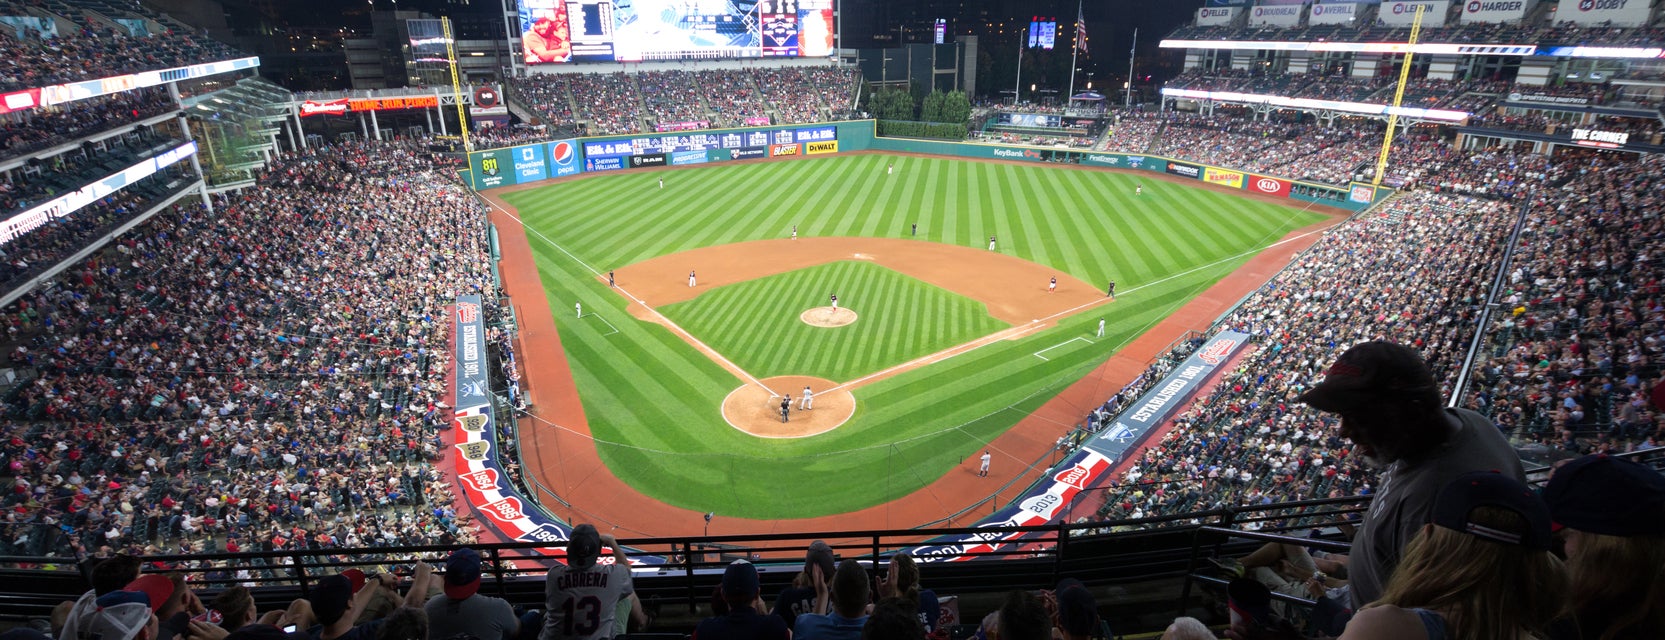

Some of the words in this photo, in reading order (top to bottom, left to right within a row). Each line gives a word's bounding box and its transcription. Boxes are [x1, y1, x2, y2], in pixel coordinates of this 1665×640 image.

[1323, 6, 1353, 14] AVERILL
[1481, 1, 1521, 11] HARDER
[1595, 0, 1627, 9] DOBY
[1208, 9, 1229, 17] FELLER
[1263, 7, 1297, 16] BOUDREAU
[302, 103, 346, 112] Budweiser
[350, 100, 380, 111] HOME
[382, 99, 404, 109] RUN
[405, 97, 438, 109] PORCH
[797, 131, 812, 140] Elk
[811, 130, 820, 139] &
[820, 129, 835, 138] Elk
[1571, 129, 1590, 139] THE
[1589, 130, 1629, 144] CORNER
[586, 145, 605, 155] Elk
[605, 144, 614, 154] &
[615, 143, 633, 153] Elk
[774, 145, 798, 156] BLASTER
[994, 149, 1023, 158] KeyBank
[673, 152, 707, 164] PROGRESSIVE
[1089, 154, 1119, 164] FirstEnergy
[483, 159, 498, 171] 811
[515, 159, 545, 170] Cleveland
[557, 166, 574, 175] pepsi
[522, 168, 539, 176] Clinic
[1261, 181, 1277, 190] KIA
[463, 325, 478, 360] ESTABLISHED
[1198, 339, 1236, 365] Indians
[1130, 378, 1189, 423] ESTABLISHED
[467, 417, 480, 430] 1920
[467, 443, 482, 459] 1948
[472, 470, 494, 490] 1954
[494, 498, 520, 519] 1995
[1030, 494, 1058, 513] 2013
[558, 572, 608, 591] CABRERA
[562, 595, 602, 637] 13
